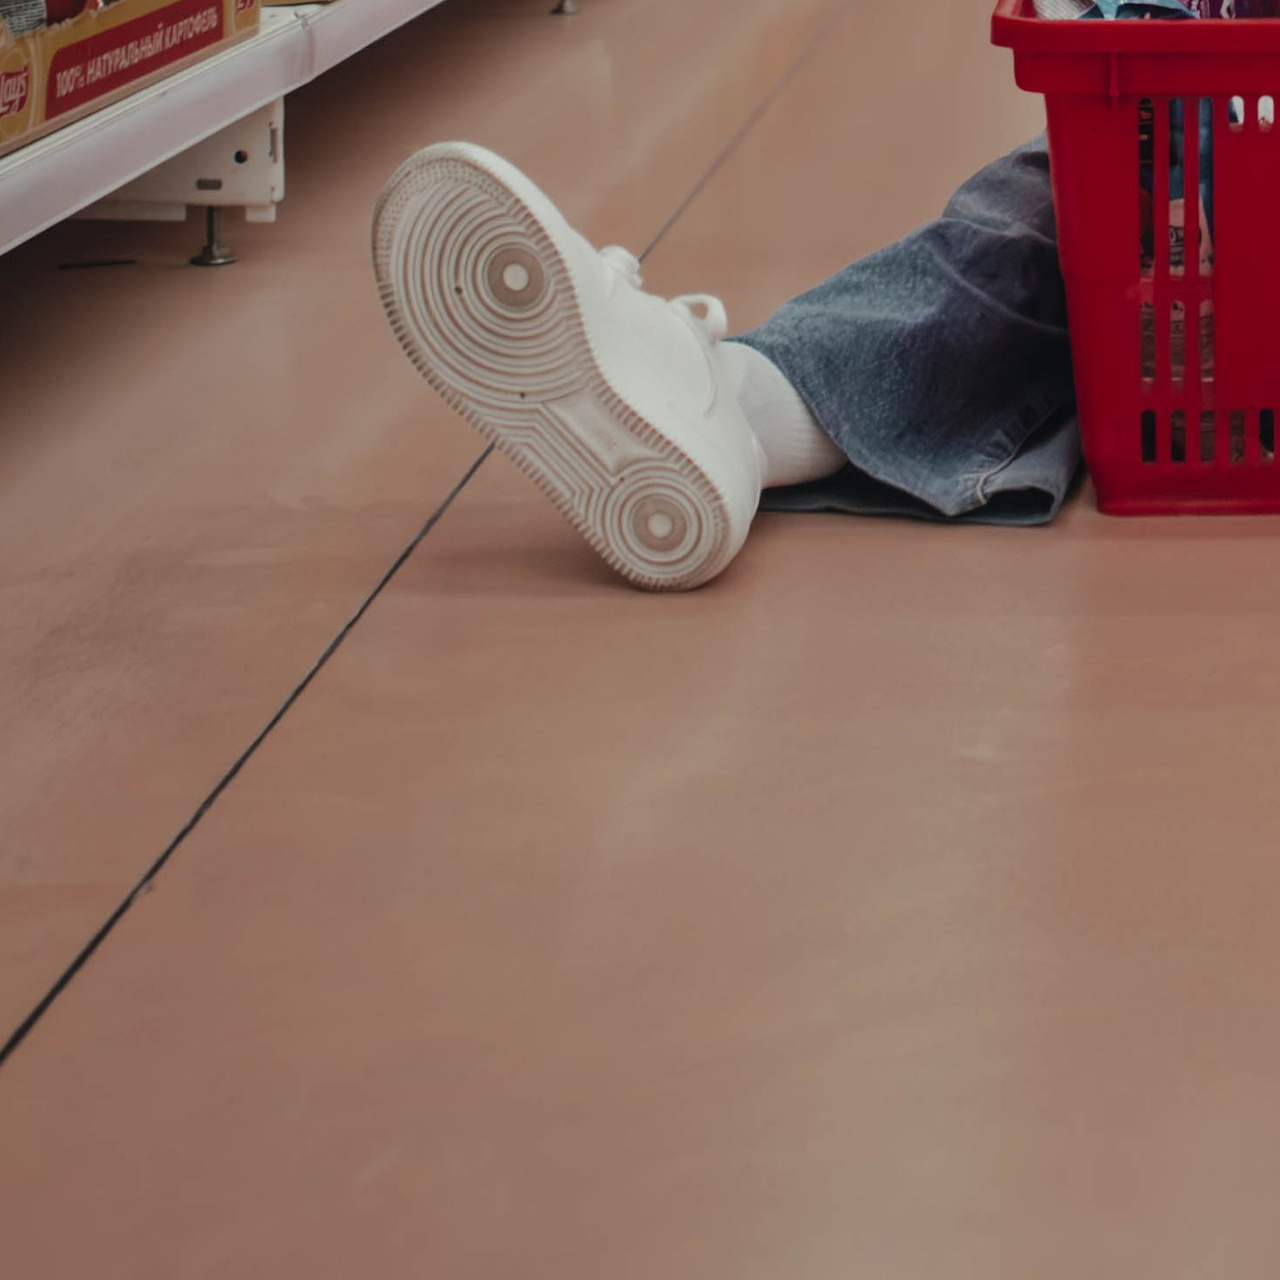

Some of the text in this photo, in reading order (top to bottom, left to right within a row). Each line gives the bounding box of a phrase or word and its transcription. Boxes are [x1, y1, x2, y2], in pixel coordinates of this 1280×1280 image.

[55, 5, 220, 98] 100% НАТУРАЛЬНЫЙ КАРТОФЕЛЬ
